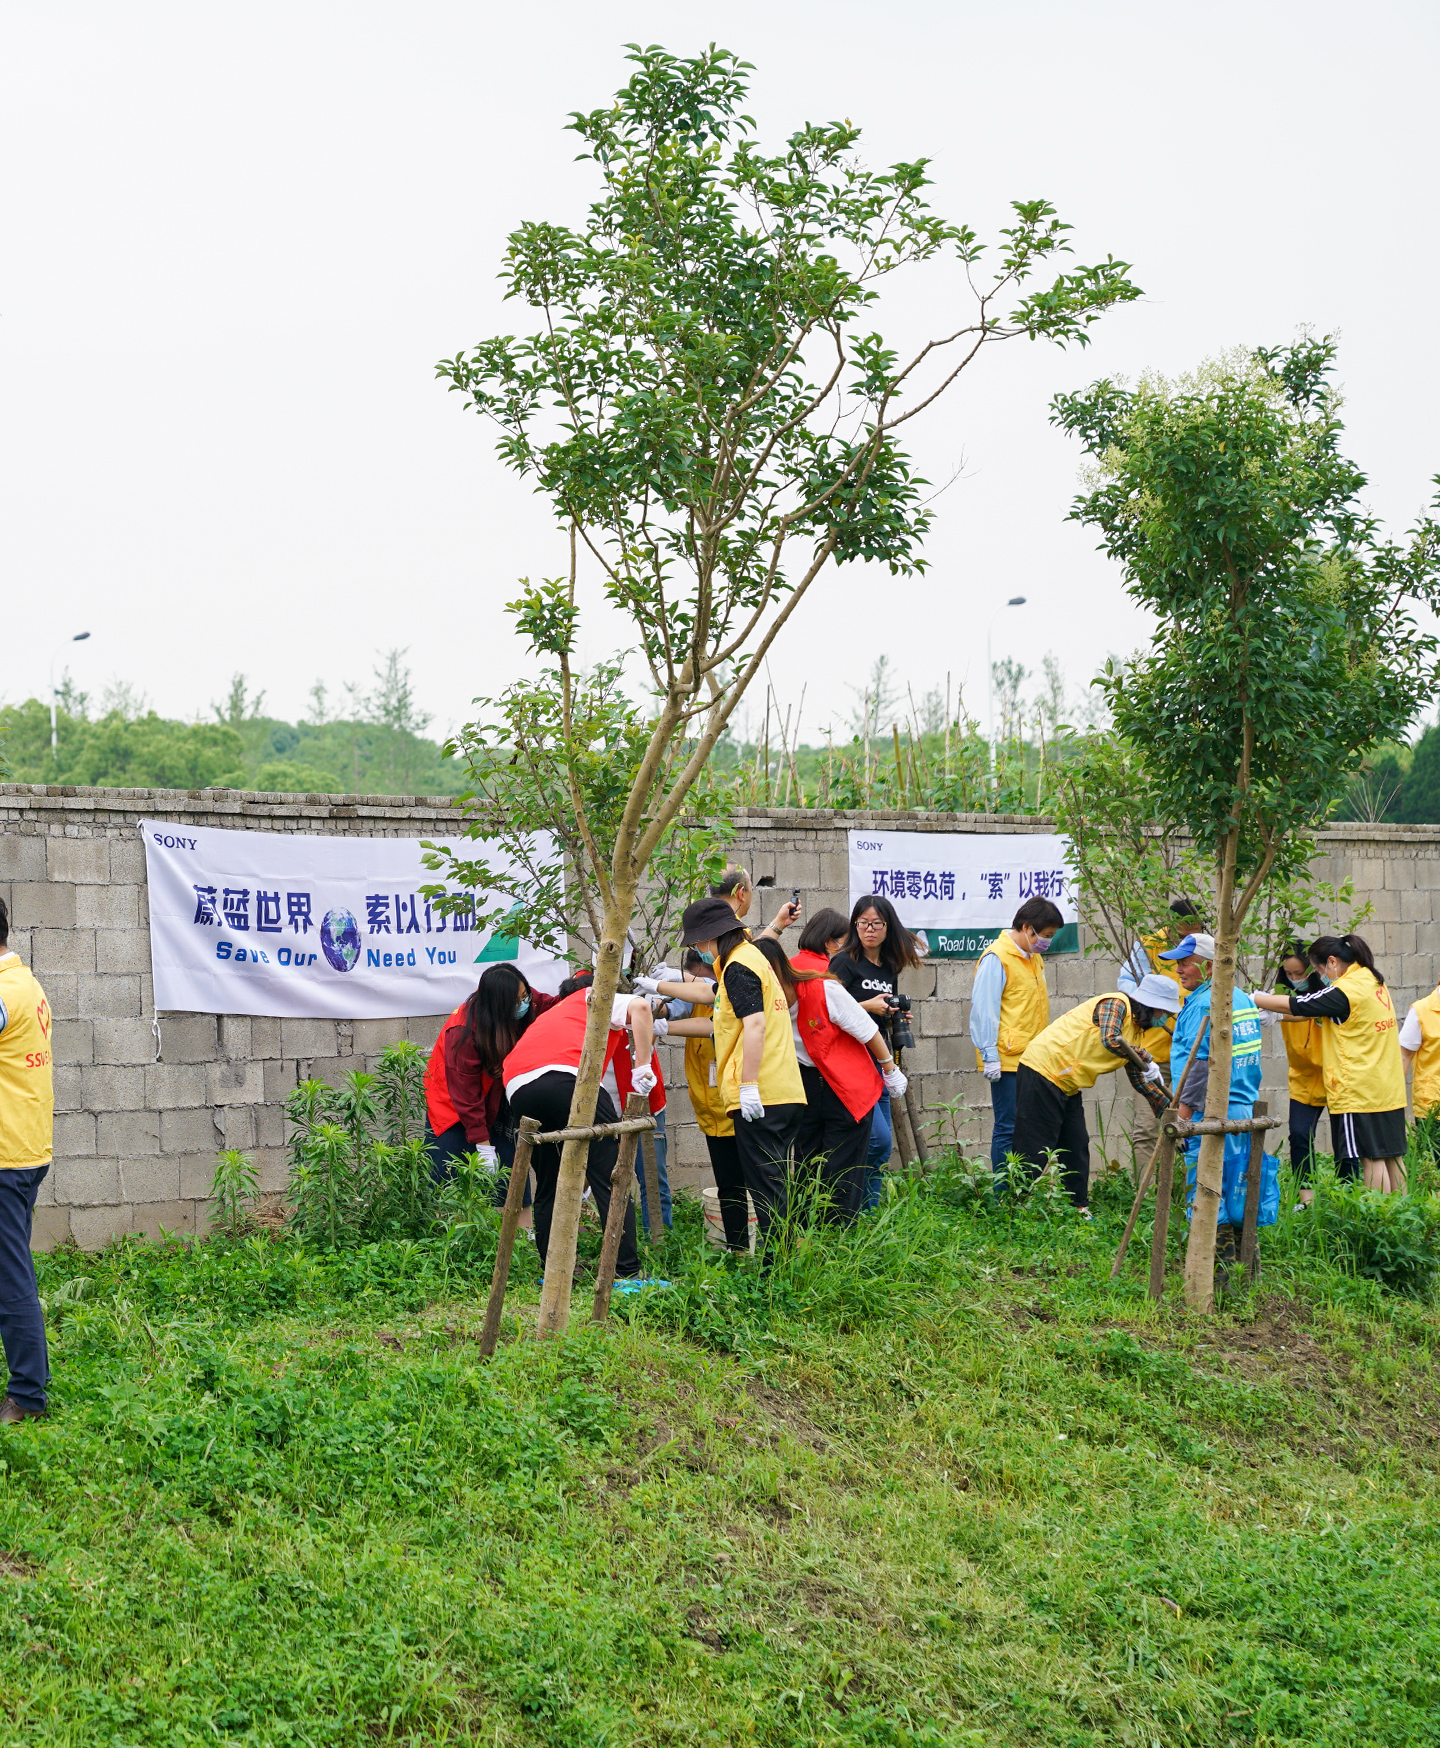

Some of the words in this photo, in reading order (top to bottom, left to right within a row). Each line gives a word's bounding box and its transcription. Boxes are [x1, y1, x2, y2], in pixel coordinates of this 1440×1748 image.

[153, 833, 197, 851] SONY
[856, 840, 883, 851] SONY
[193, 884, 314, 935] 蔚蓝世界
[938, 935, 965, 951] Road
[966, 937, 976, 951] to
[977, 935, 997, 951] Zer
[216, 941, 270, 964] Save
[277, 947, 317, 966] Our
[366, 948, 416, 967] Need
[425, 947, 456, 965] You
